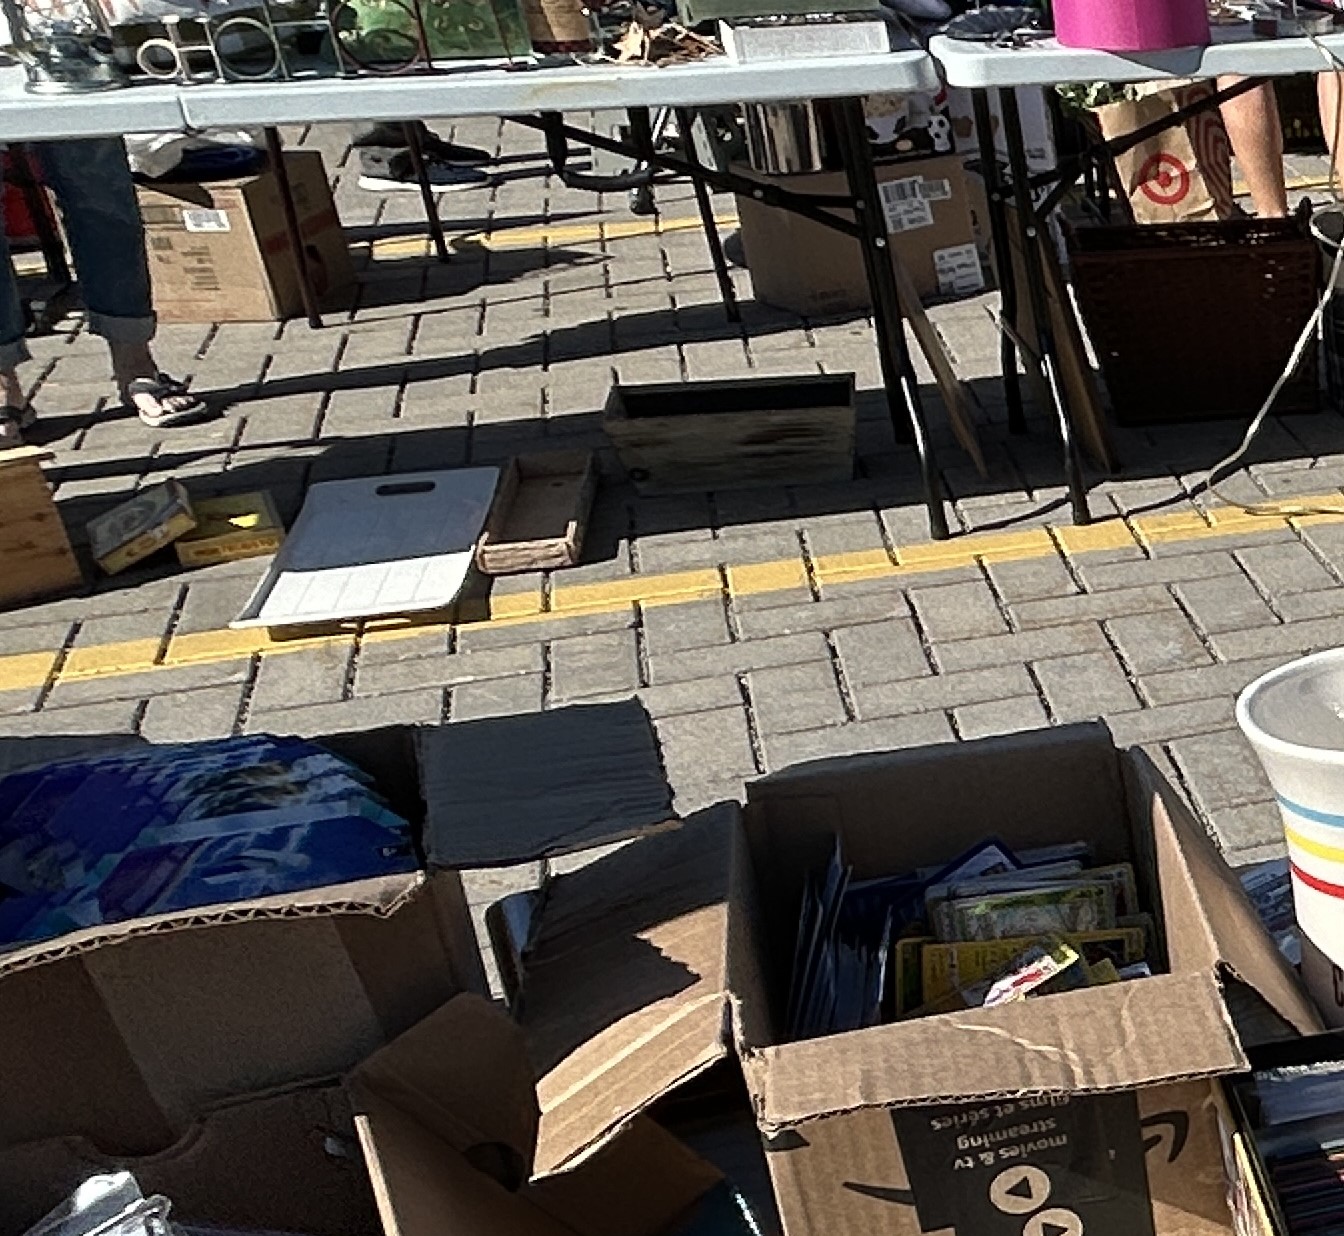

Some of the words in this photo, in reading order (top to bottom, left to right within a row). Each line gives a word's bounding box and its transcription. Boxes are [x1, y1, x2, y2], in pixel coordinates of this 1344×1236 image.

[996, 1103, 1015, 1118] et
[930, 1109, 991, 1132] séries
[957, 1116, 1056, 1150] streaming
[998, 1133, 1068, 1160] movies
[952, 1157, 974, 1171] tv
[978, 1151, 996, 1167] &
